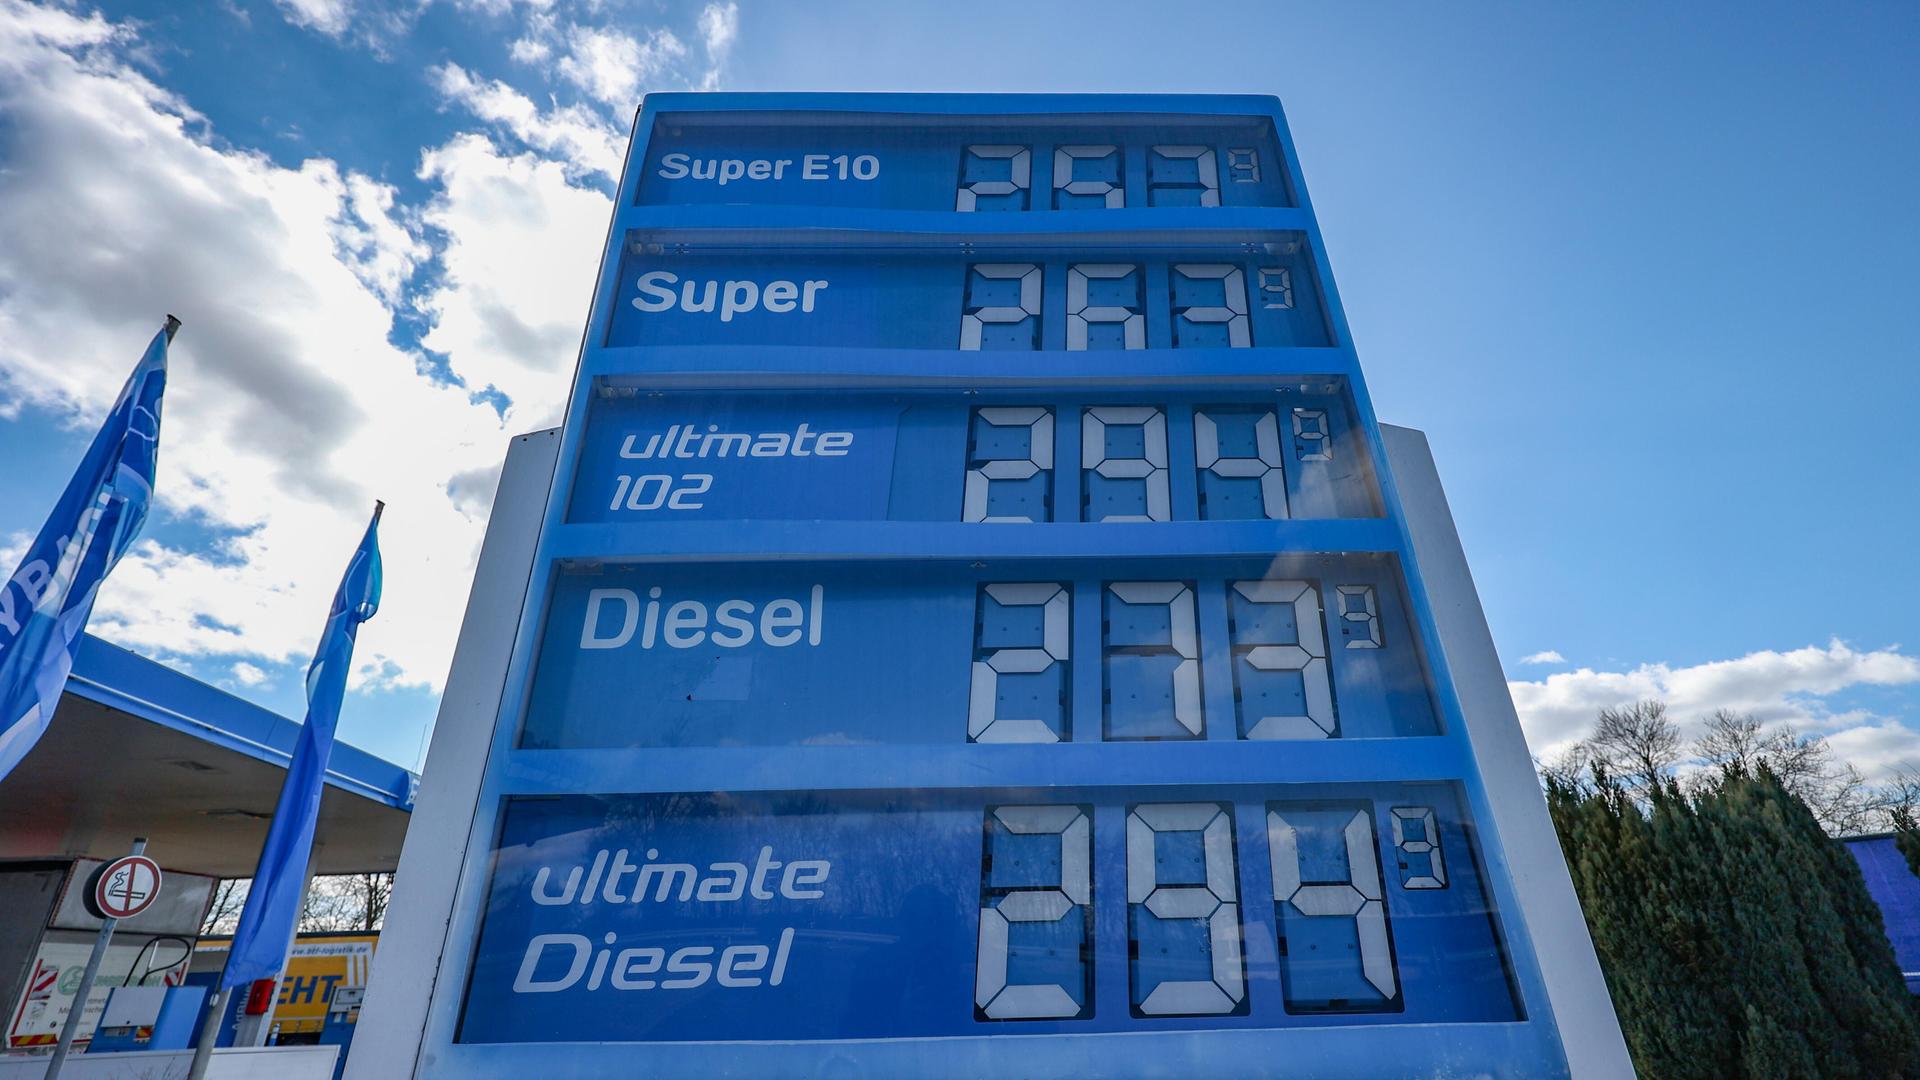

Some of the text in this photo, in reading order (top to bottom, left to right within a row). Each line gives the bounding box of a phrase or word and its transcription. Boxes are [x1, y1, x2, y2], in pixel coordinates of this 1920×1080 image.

[658, 153, 880, 186] Super E10
[631, 271, 829, 322] Super
[619, 423, 854, 459] ultimate
[610, 474, 714, 511] 102
[580, 583, 825, 650] Diesel
[531, 845, 831, 906] ultimate
[513, 927, 796, 993] Diesel
